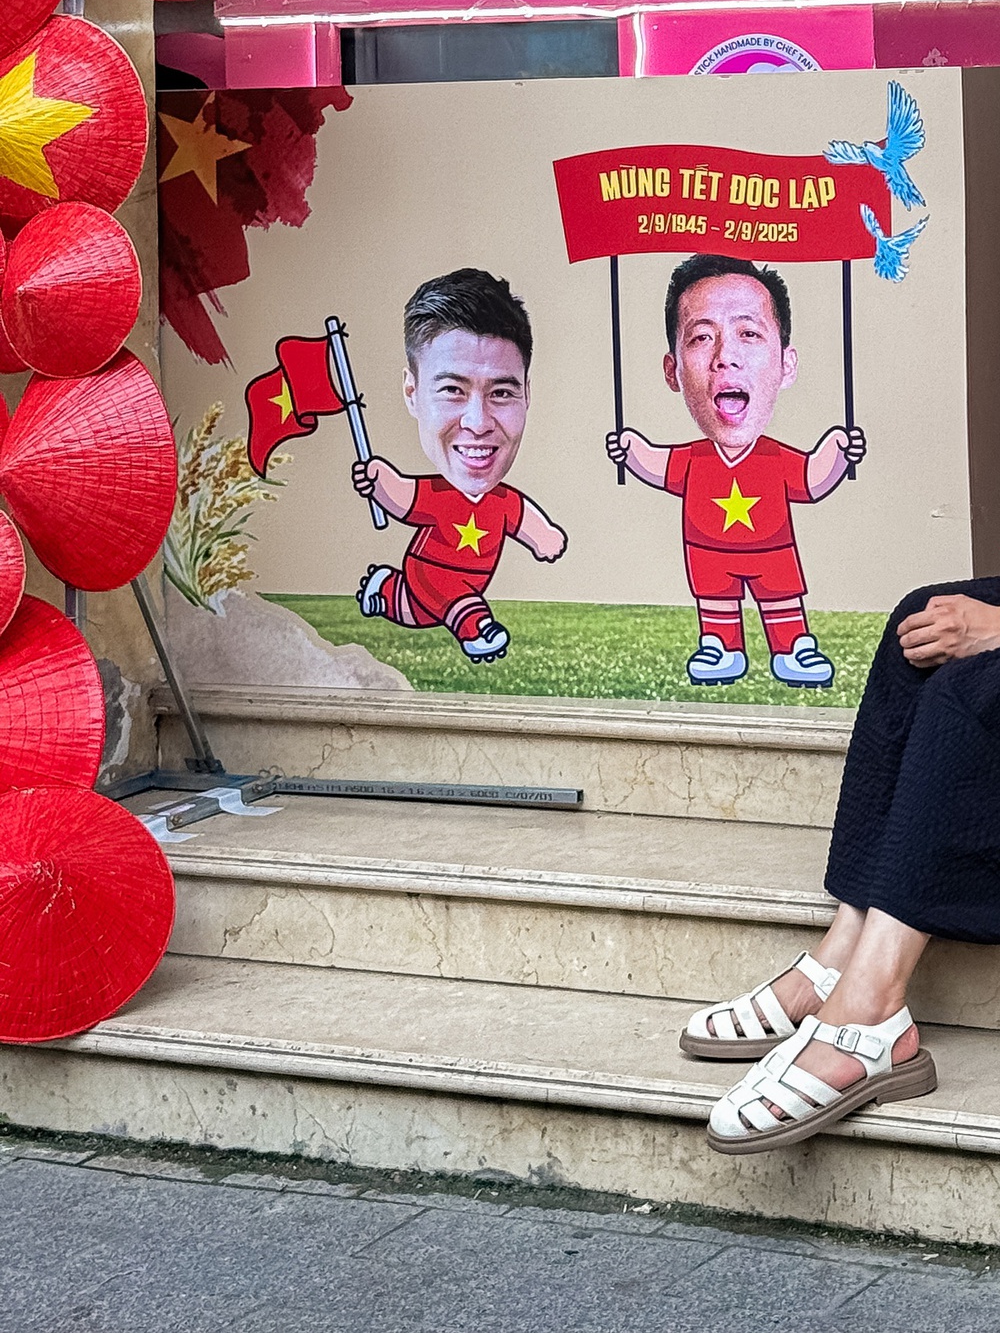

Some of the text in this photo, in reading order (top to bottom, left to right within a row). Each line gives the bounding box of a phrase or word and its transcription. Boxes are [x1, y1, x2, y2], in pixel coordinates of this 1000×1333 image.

[713, 37, 762, 60] HANDMADE
[763, 38, 775, 47] BY
[775, 41, 798, 57] CHEF
[797, 54, 813, 71] TAN
[599, 164, 836, 212] MỪNG TẾT ĐỘC LẬP
[637, 212, 708, 235] 2/9/1945
[724, 219, 798, 243] 2/9/2025
